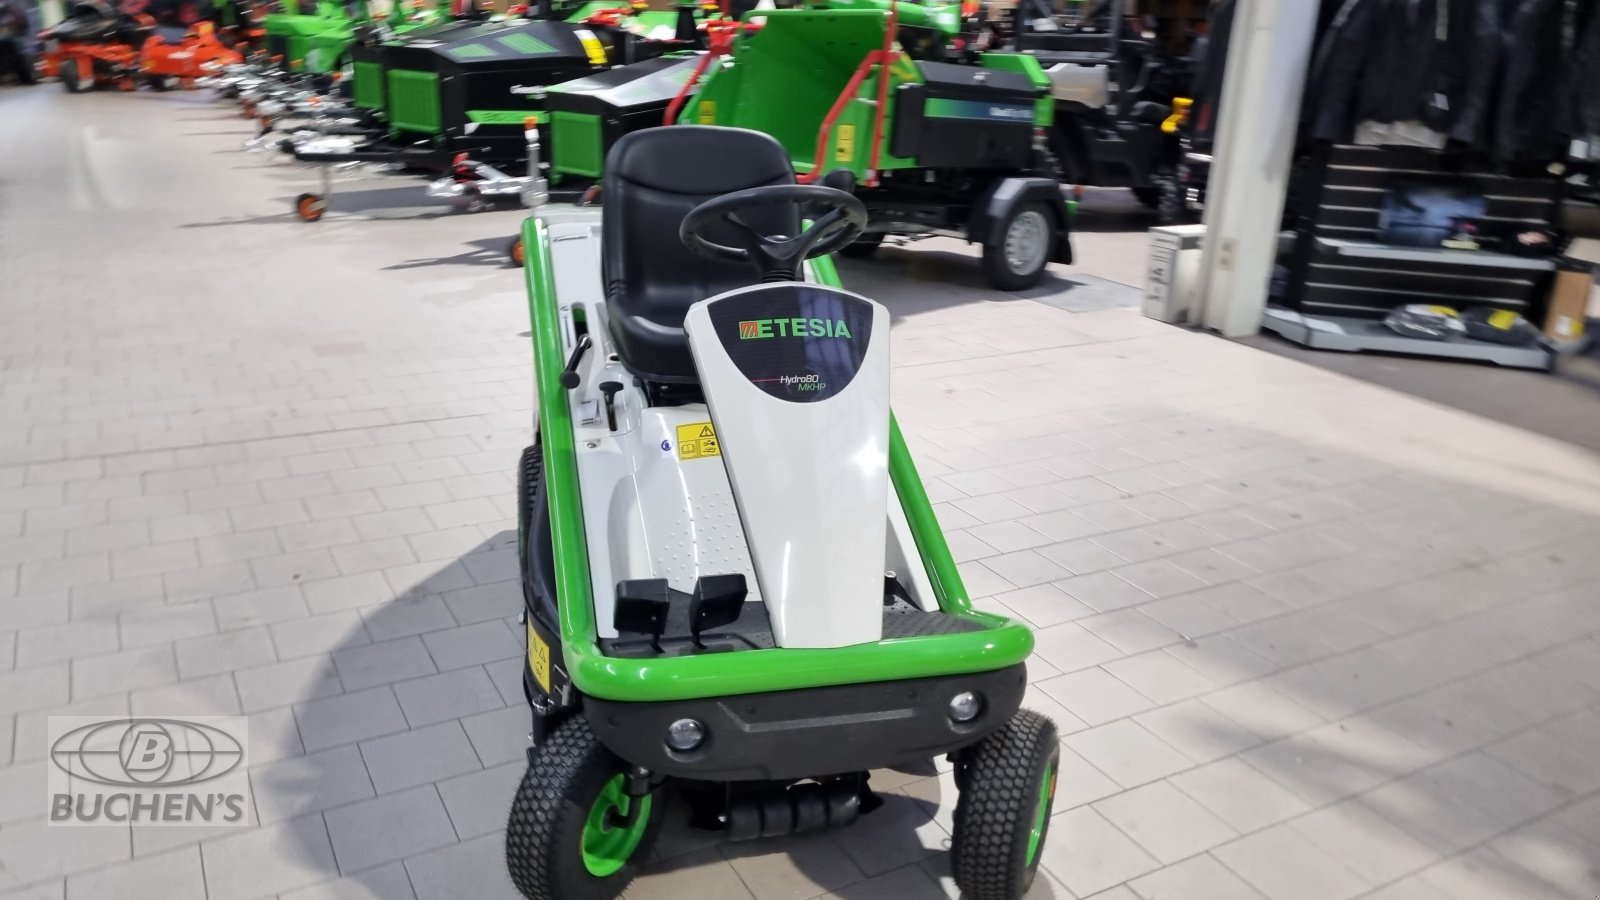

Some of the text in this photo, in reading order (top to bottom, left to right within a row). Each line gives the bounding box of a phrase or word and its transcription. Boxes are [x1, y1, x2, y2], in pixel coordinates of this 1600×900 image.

[757, 318, 852, 339] ETESIA
[780, 374, 819, 386] Hydro80
[798, 382, 826, 392] MKHP
